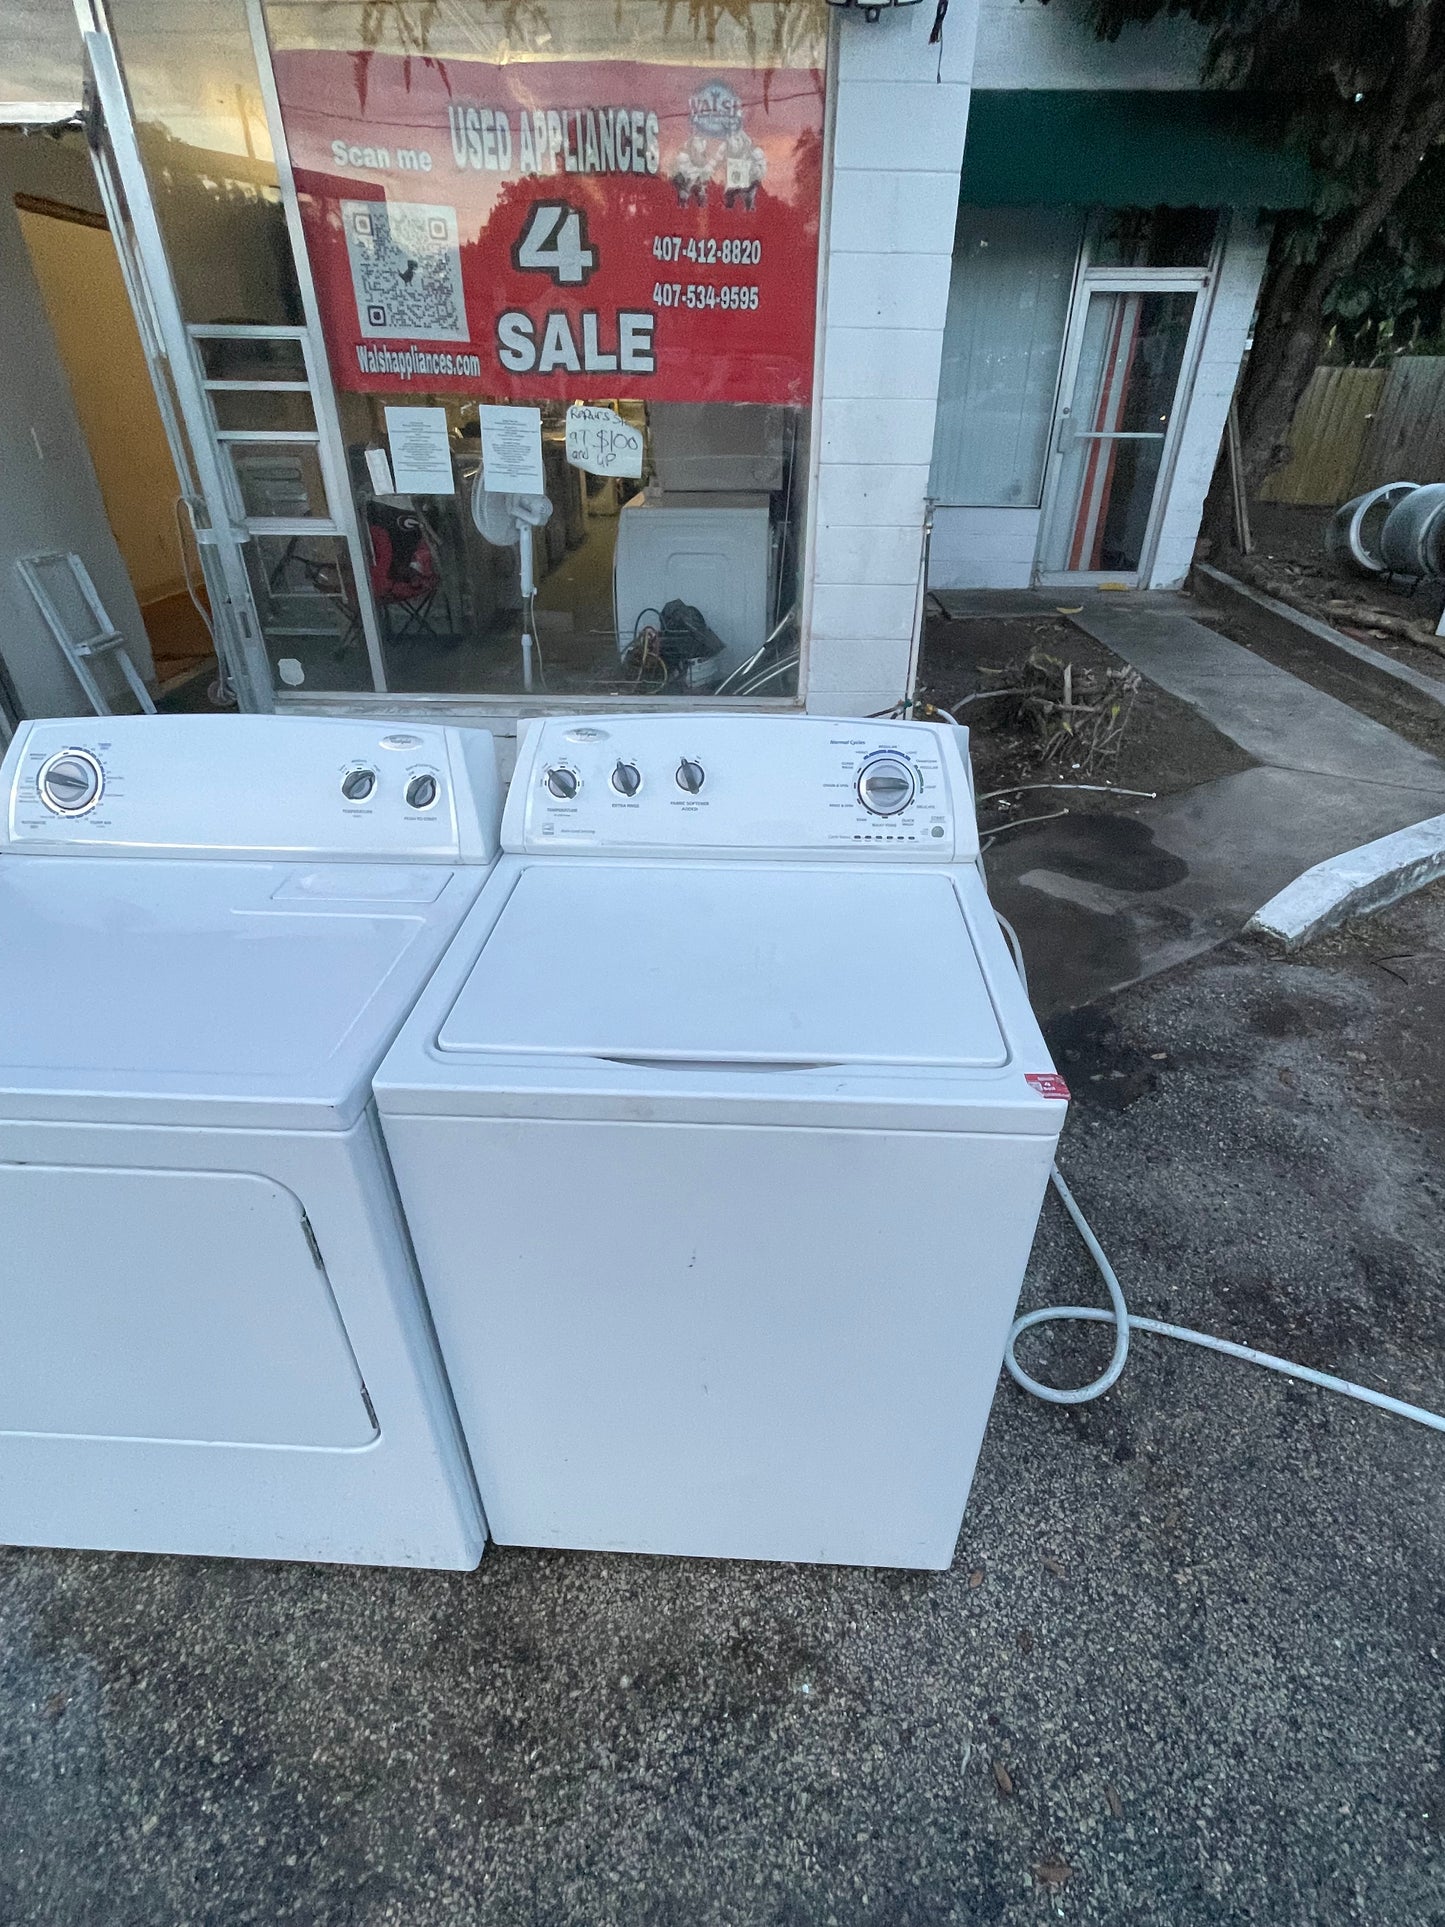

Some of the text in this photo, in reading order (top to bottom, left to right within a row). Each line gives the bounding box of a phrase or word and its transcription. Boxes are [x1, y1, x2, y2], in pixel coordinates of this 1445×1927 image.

[331, 140, 432, 172] Scan me
[449, 106, 659, 174] USED APPLIANCES
[513, 201, 598, 287] 4
[652, 235, 761, 265] 407-412-8820
[652, 282, 759, 310] 407-534-9595
[497, 308, 656, 376] SALE
[356, 346, 481, 379] Walshappliances.com
[593, 429, 639, 453] $100
